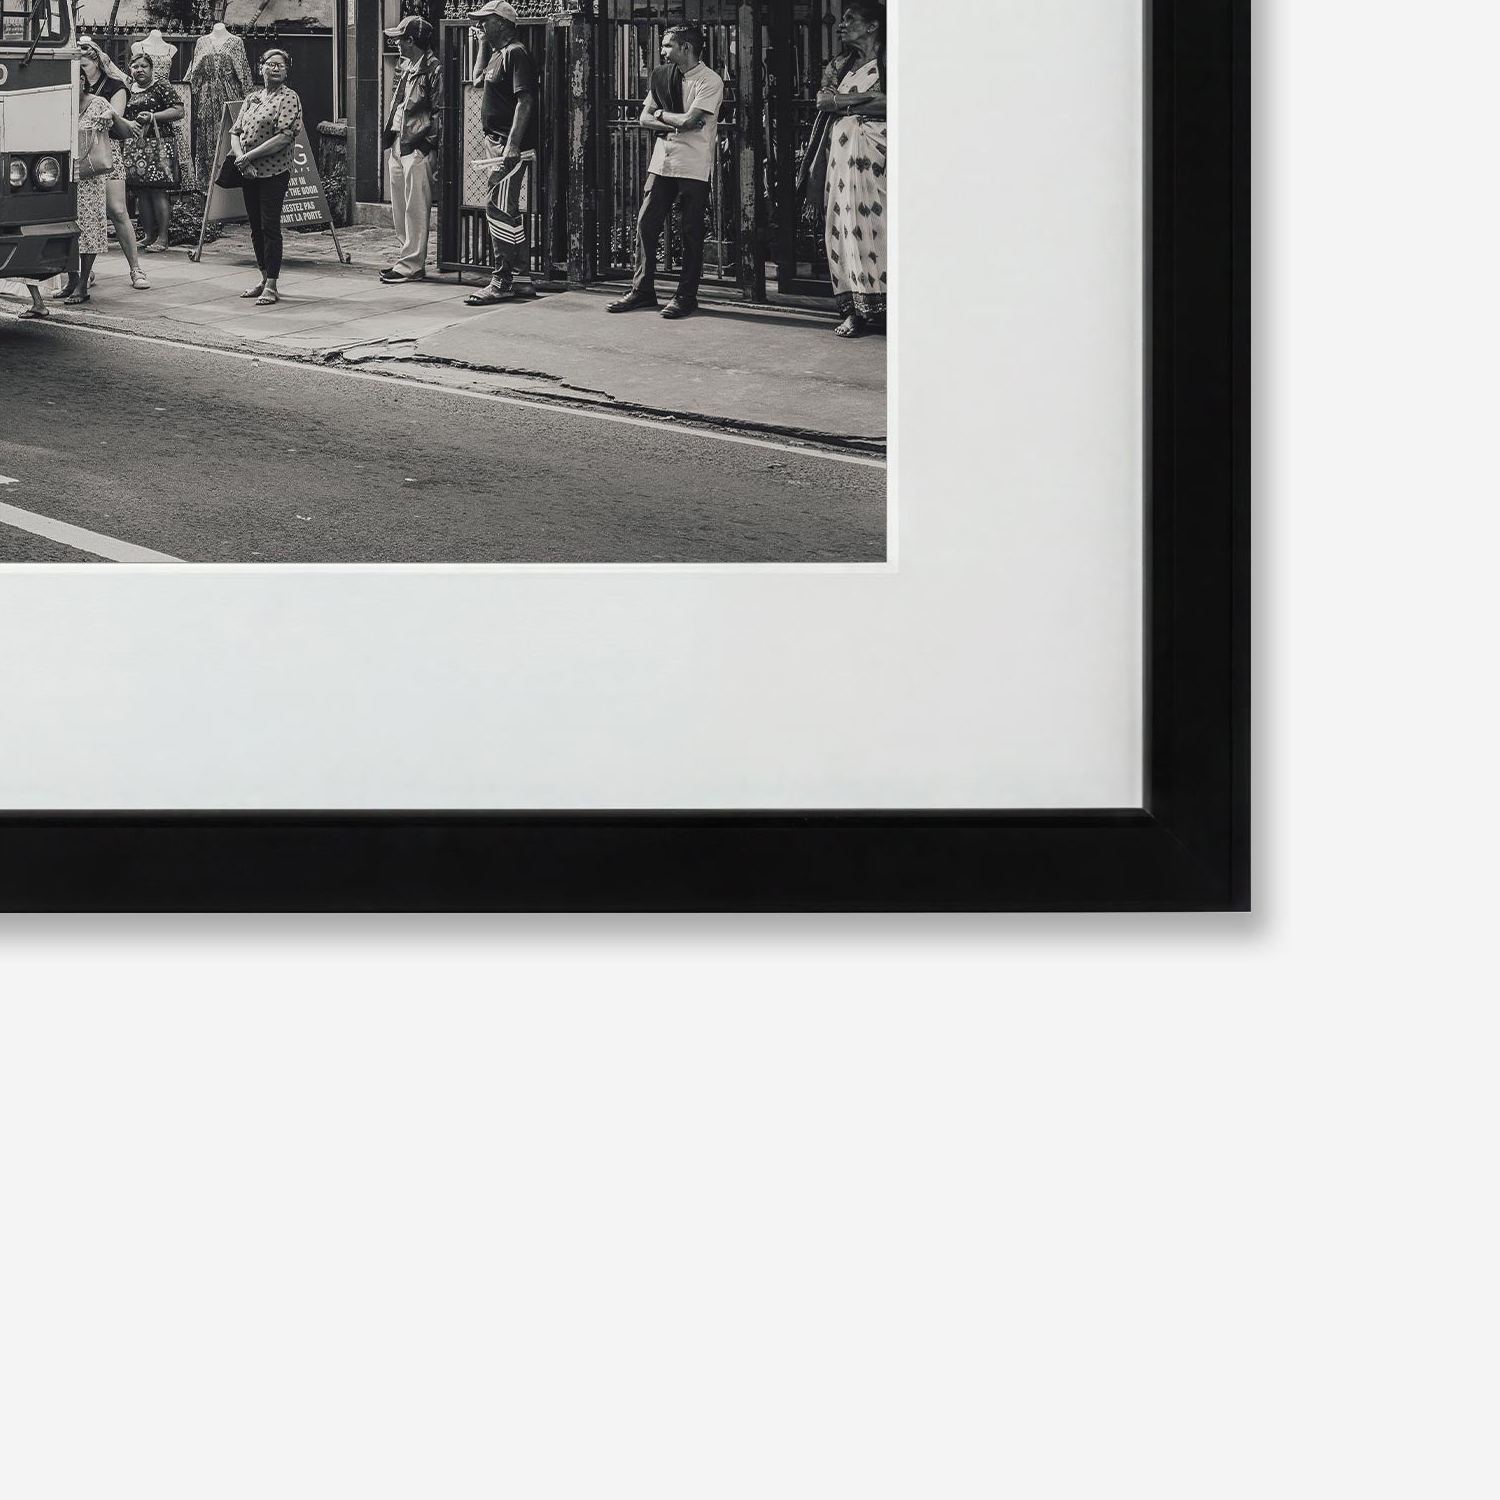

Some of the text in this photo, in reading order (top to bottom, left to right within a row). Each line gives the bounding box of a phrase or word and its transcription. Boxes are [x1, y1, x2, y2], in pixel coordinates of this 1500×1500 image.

[289, 187, 301, 197] THE
[301, 185, 319, 195] DOOR
[303, 201, 316, 211] PAS
[303, 210, 323, 220] PORTE
